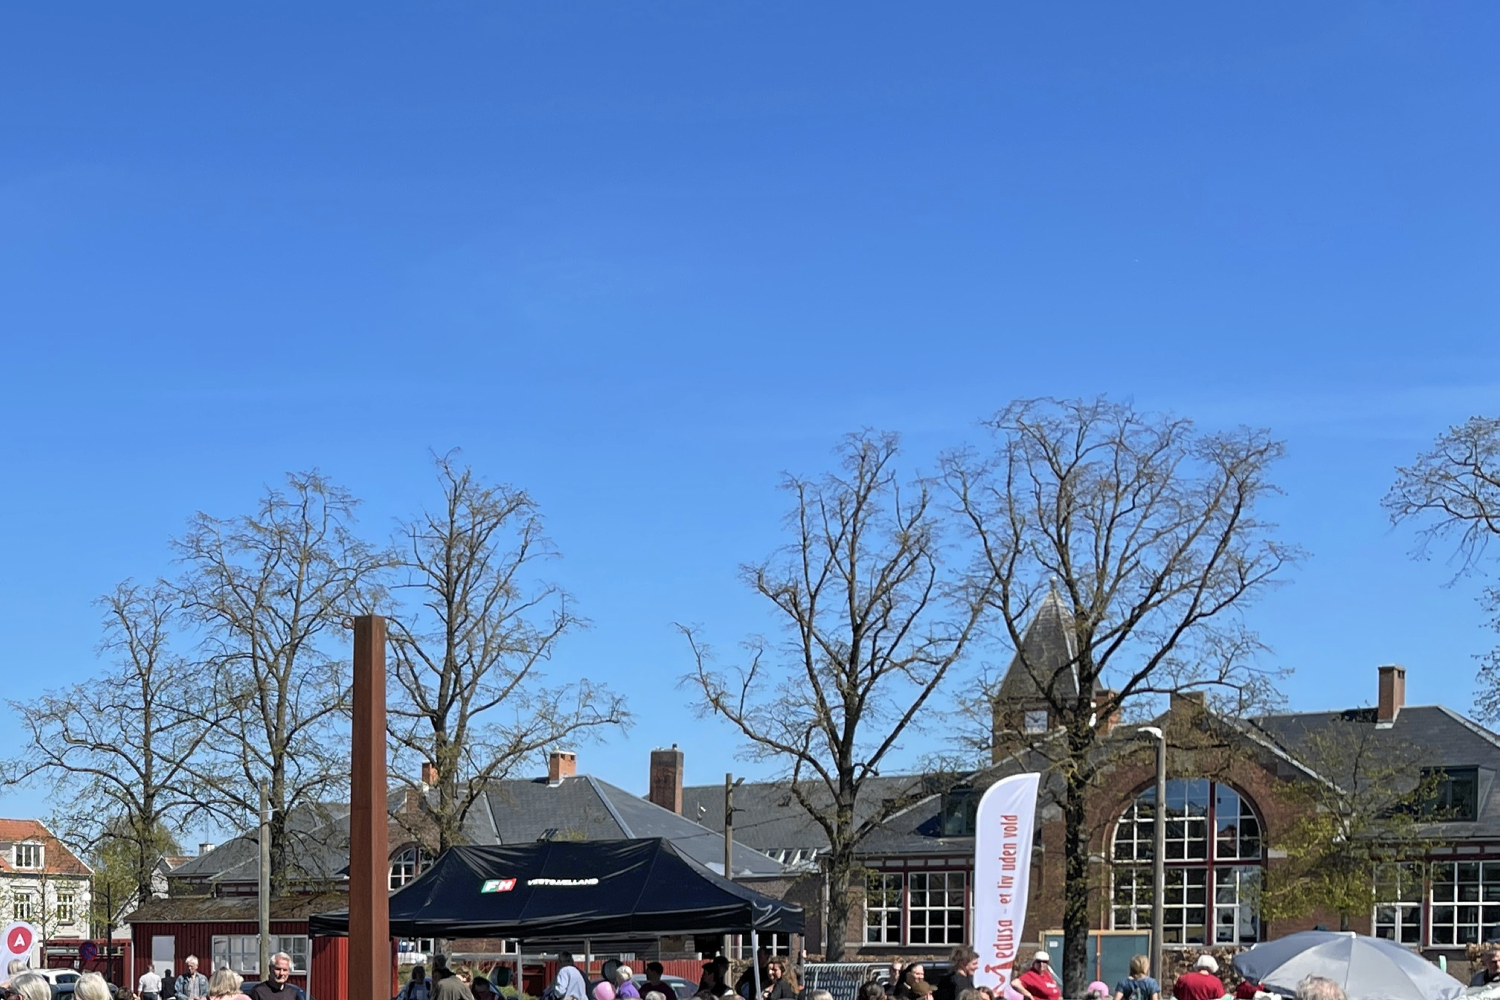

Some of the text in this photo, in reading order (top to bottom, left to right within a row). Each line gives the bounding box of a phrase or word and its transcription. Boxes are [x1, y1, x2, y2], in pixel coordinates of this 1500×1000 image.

[1000, 815, 1019, 839] vold
[998, 843, 1017, 871] uden
[484, 881, 514, 892] FH
[997, 875, 1015, 889] liv
[999, 893, 1013, 905] et
[13, 933, 26, 947] A
[984, 919, 1014, 998] Medusa
